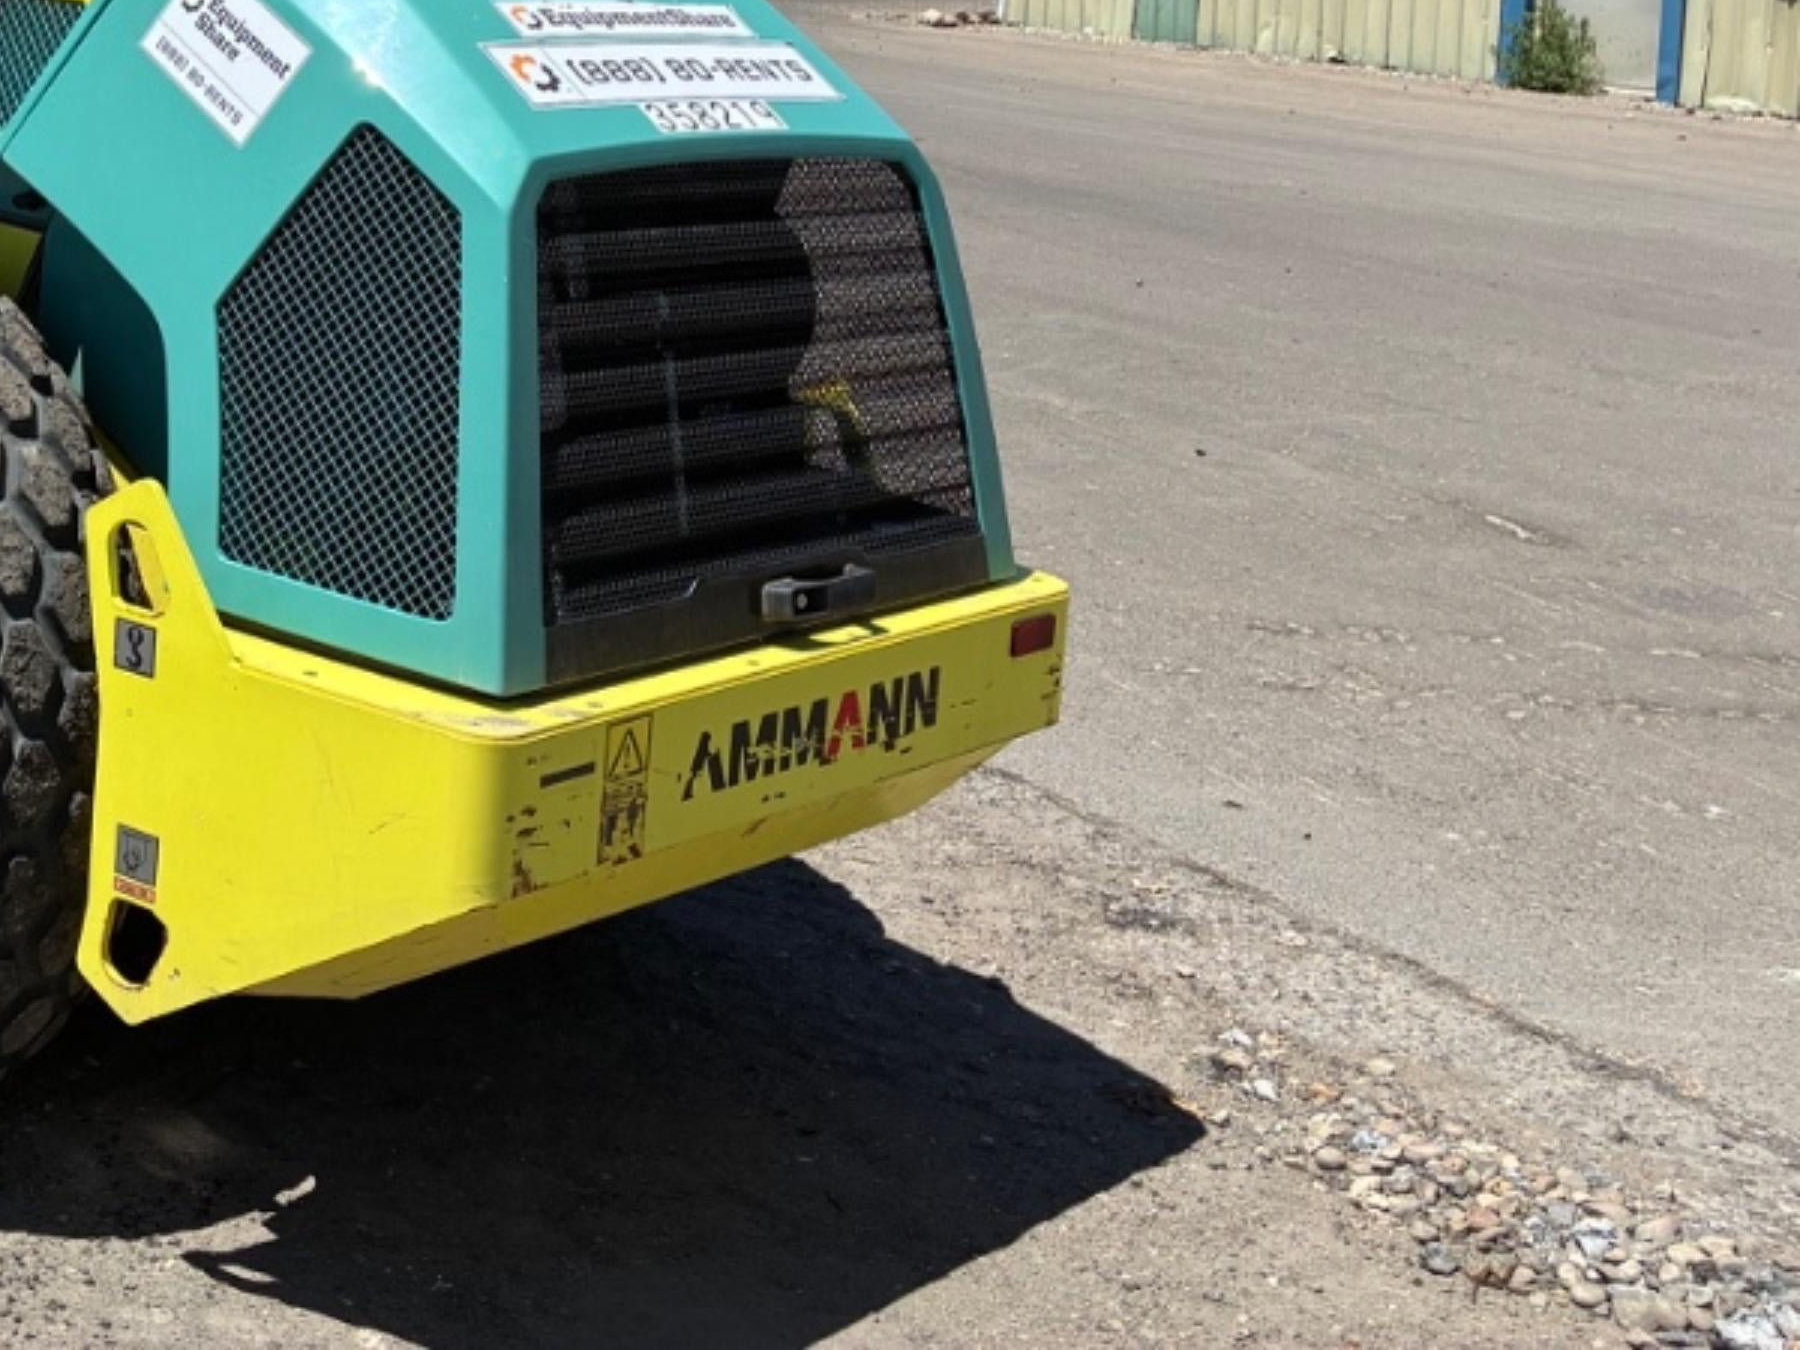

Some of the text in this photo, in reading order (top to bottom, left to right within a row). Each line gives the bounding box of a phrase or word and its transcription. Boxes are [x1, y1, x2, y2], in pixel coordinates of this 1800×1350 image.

[541, 7, 738, 30] EquipmentShare
[194, 11, 241, 63] Share
[565, 57, 815, 85] (888) 80-RENTS
[645, 101, 786, 131] 358219
[681, 665, 941, 803] AMMANN
